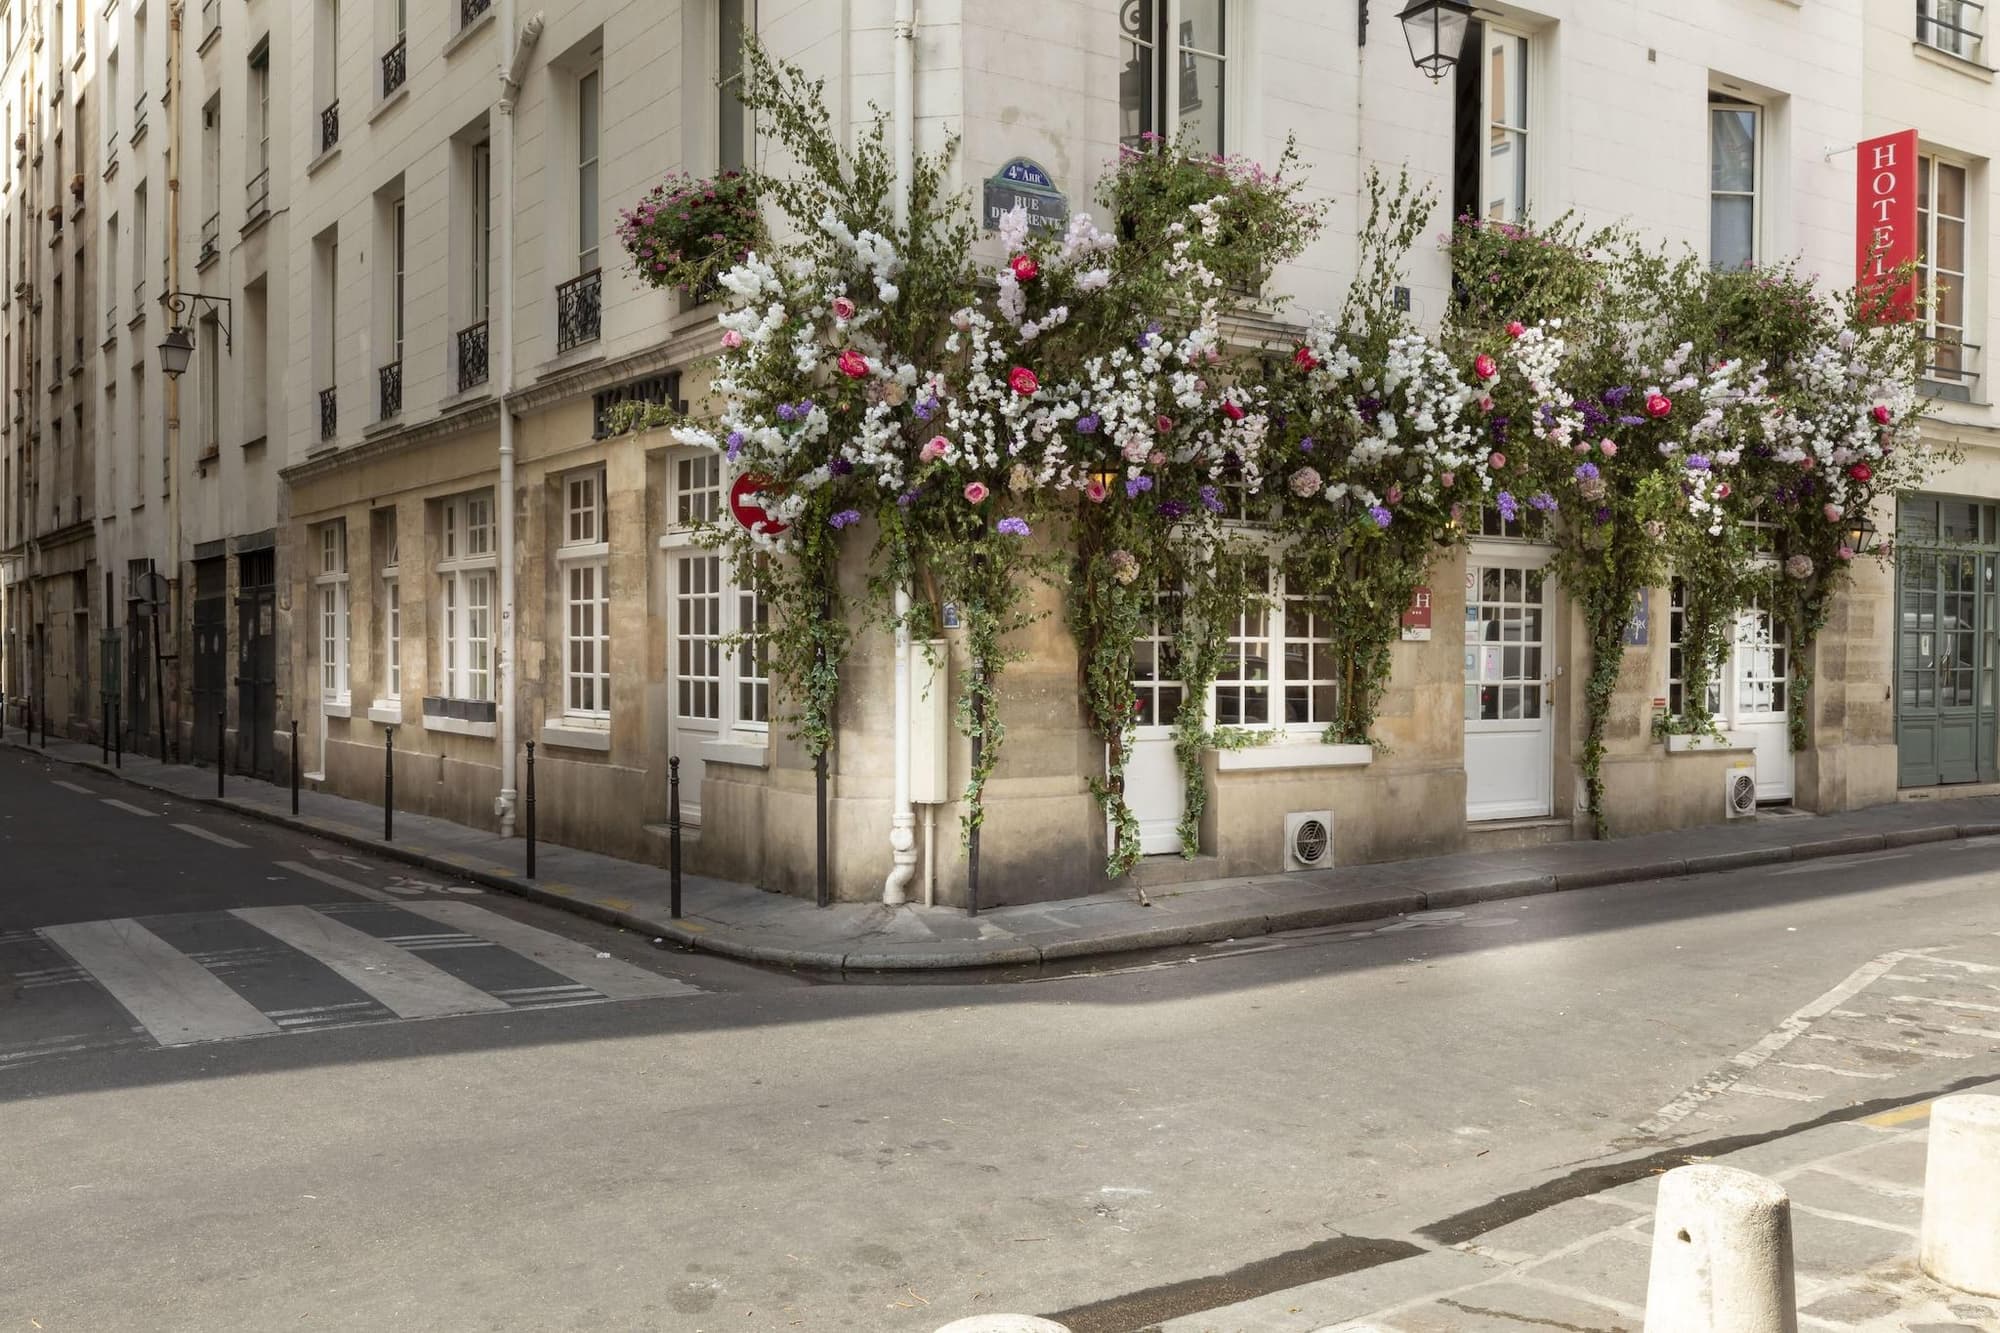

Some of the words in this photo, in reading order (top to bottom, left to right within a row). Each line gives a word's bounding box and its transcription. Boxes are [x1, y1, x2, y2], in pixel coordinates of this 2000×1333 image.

[1014, 195, 1039, 210] RUE
[1872, 143, 1897, 277] HOTEL
[1416, 593, 1430, 608] H
